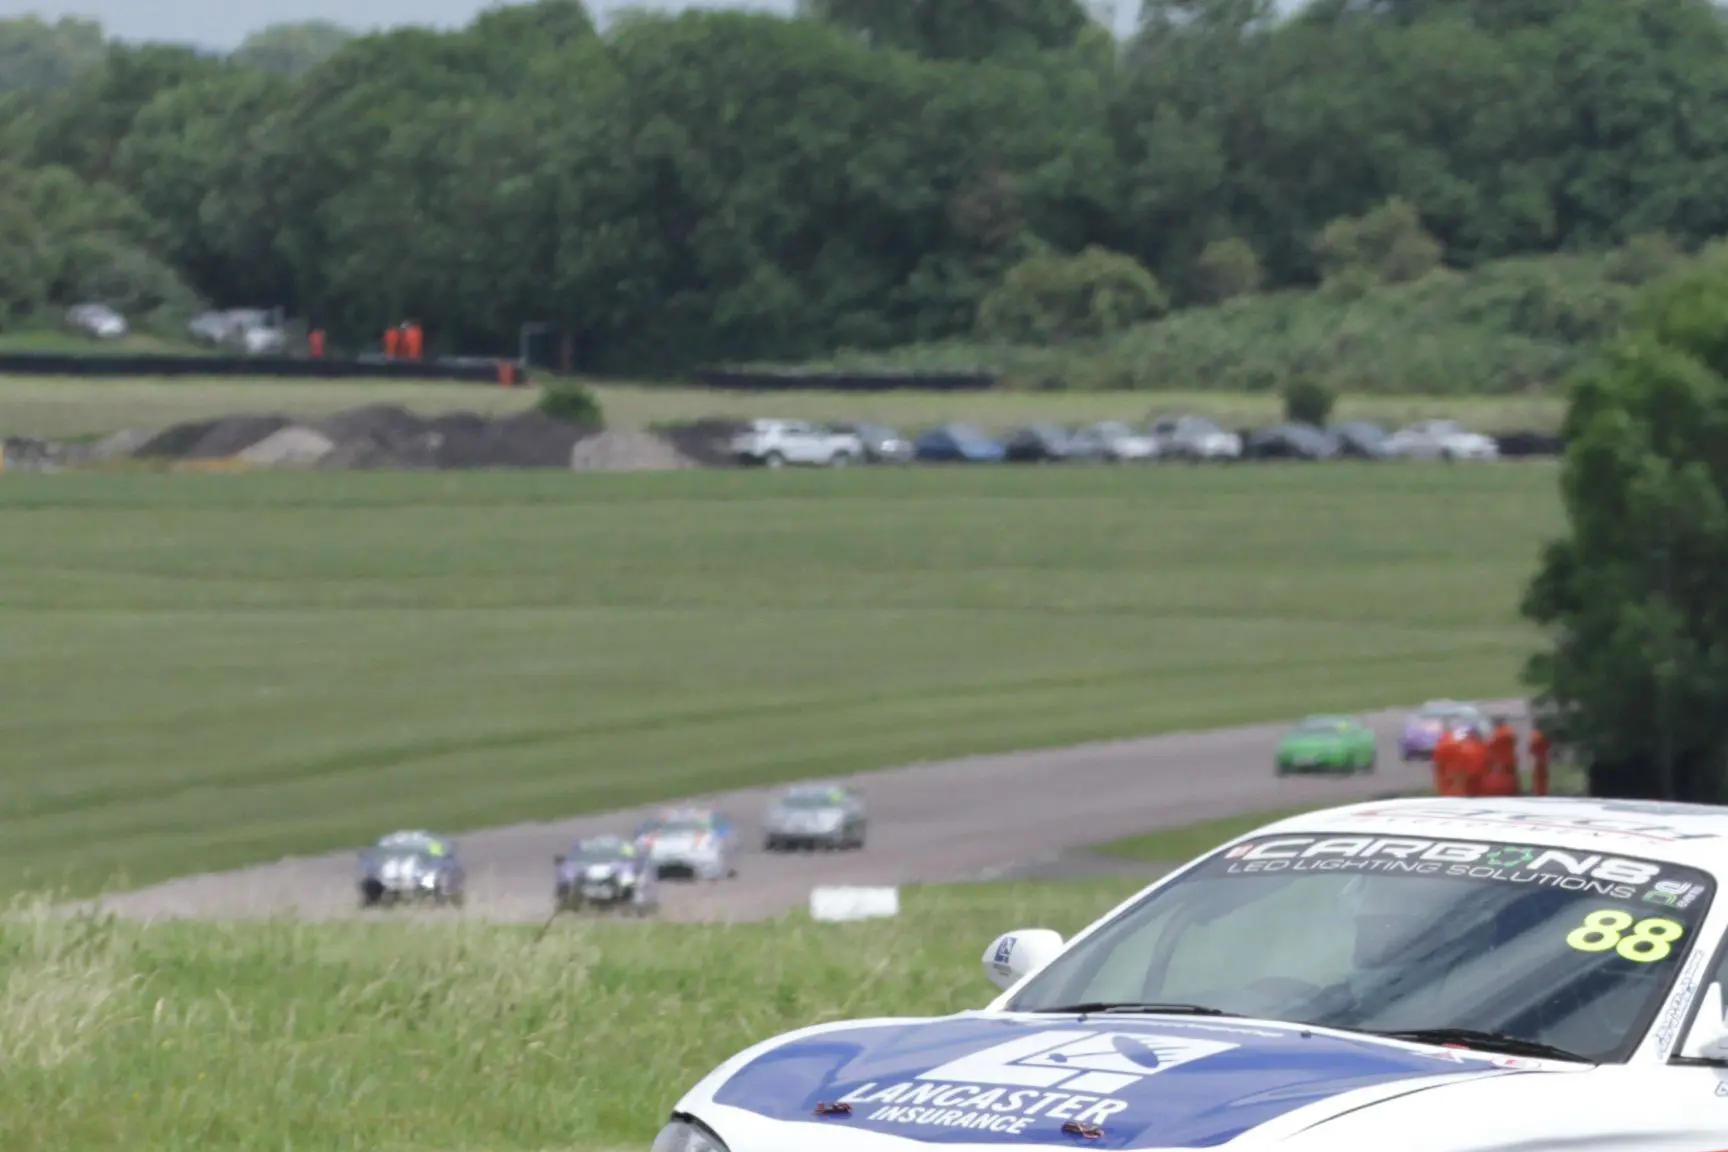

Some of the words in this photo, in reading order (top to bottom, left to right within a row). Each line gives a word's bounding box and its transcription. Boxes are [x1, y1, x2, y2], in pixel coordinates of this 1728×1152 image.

[1227, 859, 1291, 874] LED
[1293, 858, 1443, 875] LIGHTING
[1446, 864, 1637, 899] SOLUTIONS
[1566, 909, 1684, 963] 88
[837, 1081, 1130, 1125] LANCASTER
[867, 1105, 1037, 1135] INSURANCE
